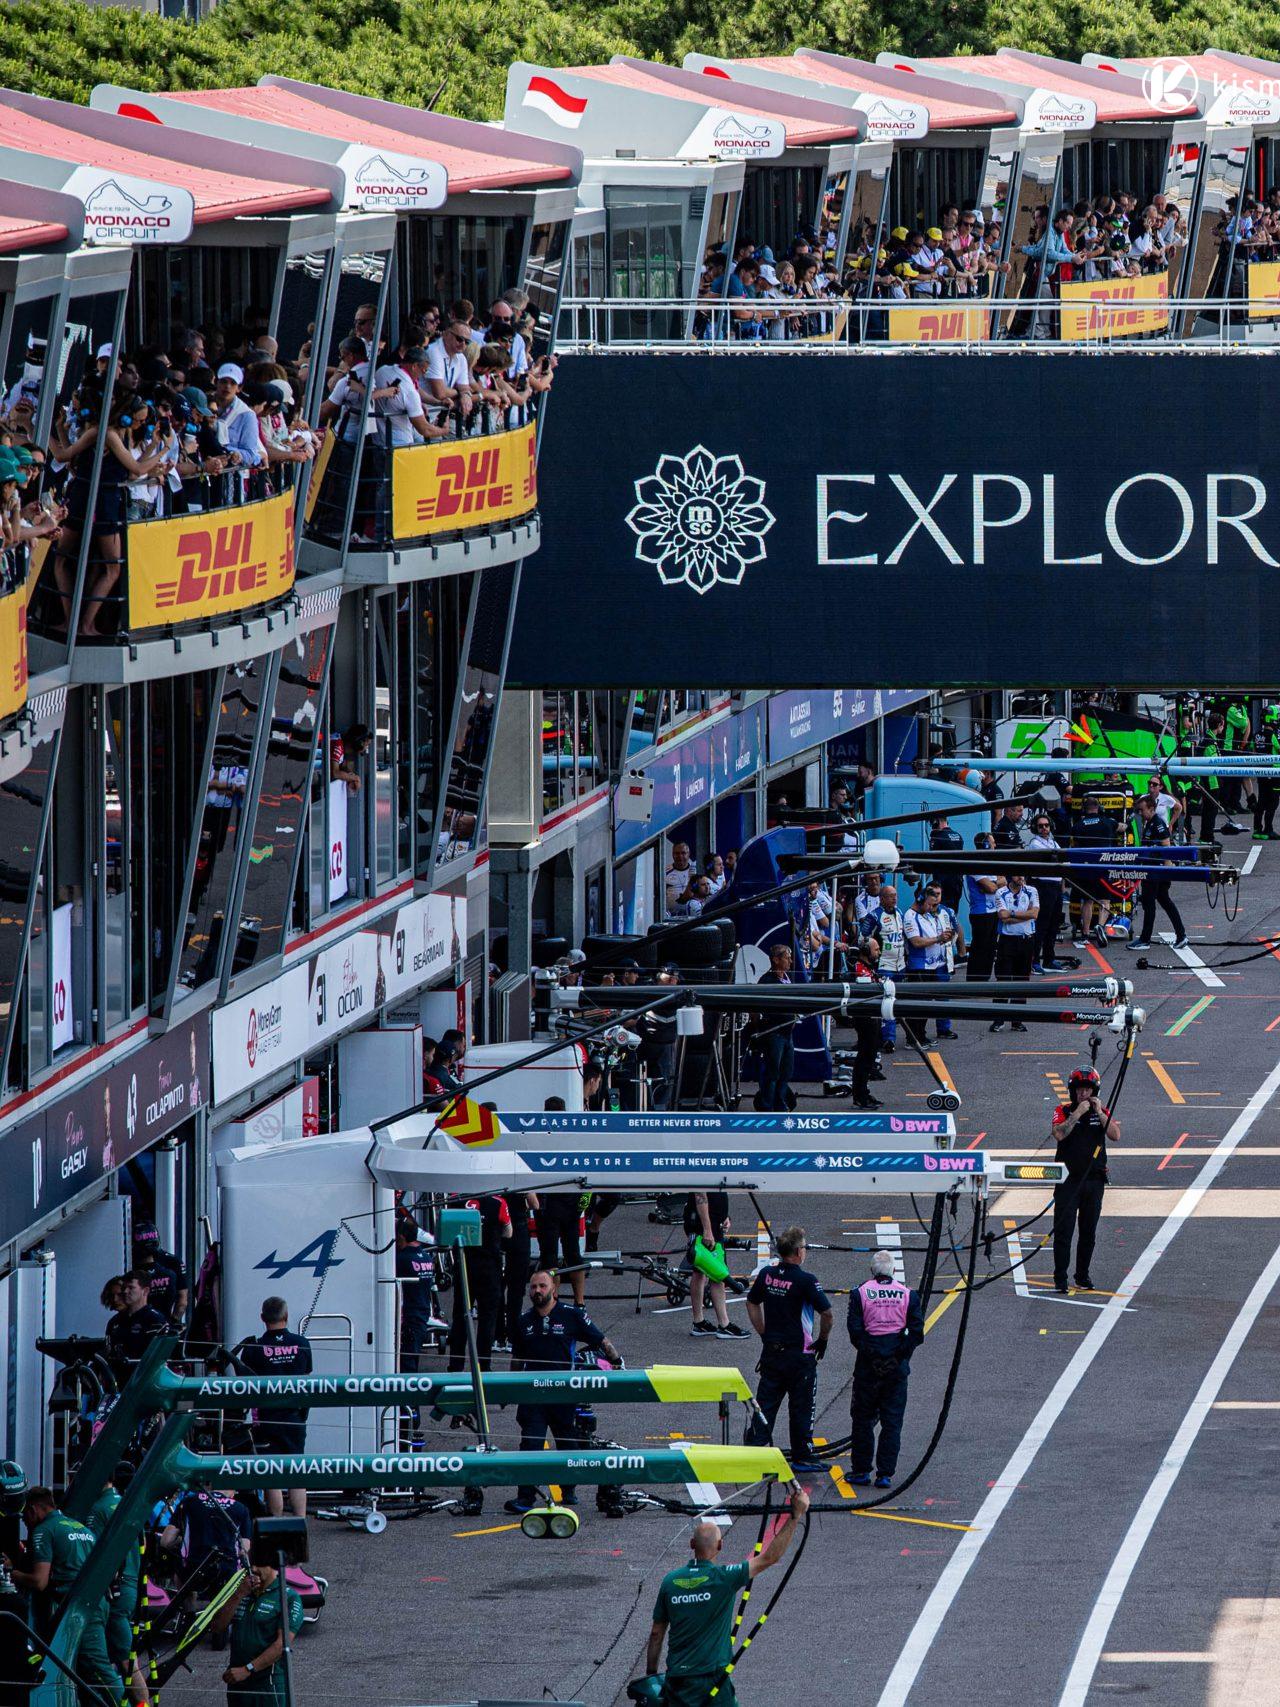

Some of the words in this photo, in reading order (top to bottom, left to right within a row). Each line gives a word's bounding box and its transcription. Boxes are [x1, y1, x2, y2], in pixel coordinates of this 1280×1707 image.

[1039, 114, 1085, 122] MONACO
[871, 129, 909, 137] CIRCUIT
[714, 140, 771, 148] MONACO
[721, 148, 764, 156] CIRCUIT
[355, 186, 428, 196] MONACO
[364, 195, 419, 206] CIRCUIT
[85, 215, 171, 228] MONACO
[95, 226, 160, 240] CIRCUIT
[434, 448, 504, 518] DHL
[175, 521, 258, 605] DHL
[1100, 852, 1138, 862] Airtasker
[1108, 869, 1148, 880] Airtasker
[412, 940, 445, 972] BEARMAN
[316, 973, 327, 1026] 31
[337, 984, 363, 1019] OCON
[126, 1073, 138, 1140] 43
[145, 1083, 185, 1126] COLAPINTO
[540, 1118, 608, 1127] CASTORE
[628, 1118, 661, 1127] BETTER
[663, 1118, 691, 1127] NEVER
[693, 1118, 721, 1127] STOPS
[796, 1118, 830, 1130] MSC
[905, 1120, 941, 1132] BWT
[61, 1146, 89, 1179] GASLY
[562, 1157, 632, 1166] CASTORE
[652, 1157, 686, 1166] BETTER
[688, 1157, 717, 1166] NEVER
[720, 1157, 749, 1166] STOPS
[828, 1156, 863, 1168] MSC
[939, 1158, 976, 1171] BWT
[773, 1279, 793, 1290] BWT
[878, 1289, 905, 1299] BWT
[275, 1345, 299, 1355] BWT
[199, 1379, 260, 1396] ASTON
[266, 1378, 337, 1394] MARTIN
[344, 1376, 433, 1393] aramco
[533, 1379, 553, 1388] Built
[570, 1376, 608, 1388] arm
[219, 1458, 284, 1476] ASTON
[290, 1458, 363, 1474] MARTIN
[371, 1456, 464, 1473] aramco
[567, 1459, 588, 1468] Built
[605, 1455, 645, 1468] arm
[671, 1592, 711, 1604] aramco
